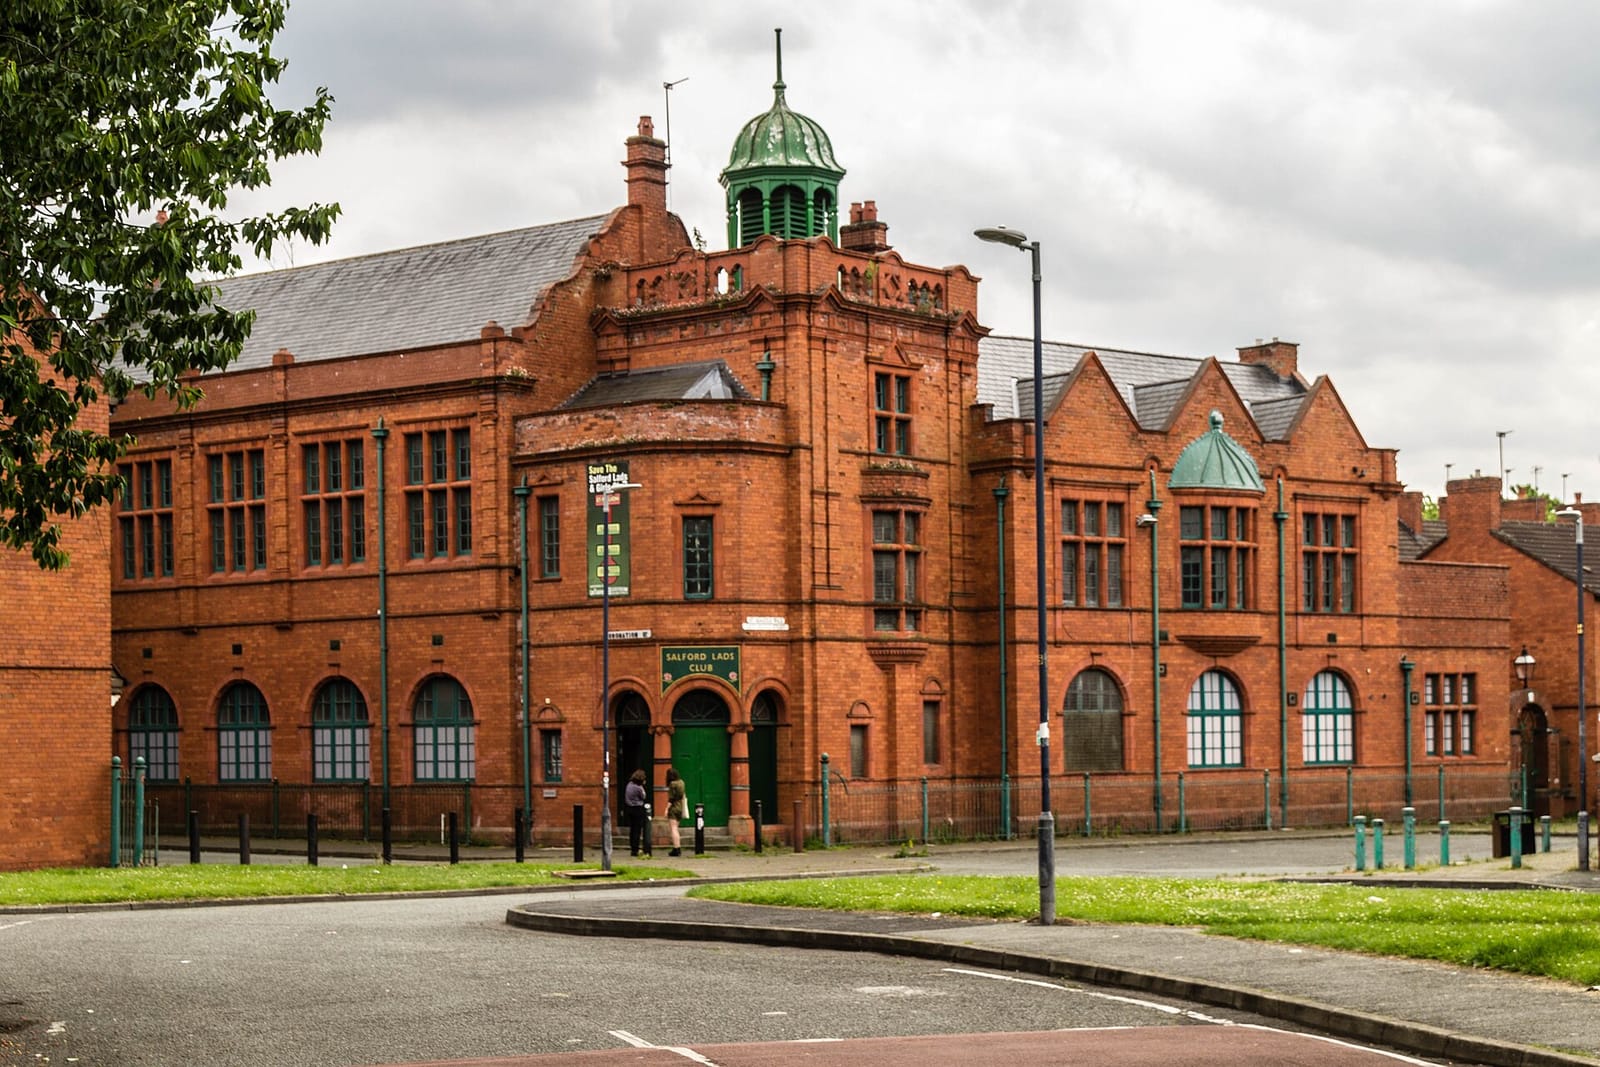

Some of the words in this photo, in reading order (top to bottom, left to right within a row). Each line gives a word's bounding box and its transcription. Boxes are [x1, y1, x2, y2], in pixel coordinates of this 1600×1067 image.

[589, 466, 604, 474] Save
[605, 464, 617, 473] The
[589, 474, 611, 483] Salford
[613, 472, 628, 481] Lads
[589, 483, 595, 493] &
[666, 652, 707, 661] SALFORD
[711, 652, 735, 660] LADS
[689, 663, 713, 672] CLUB
